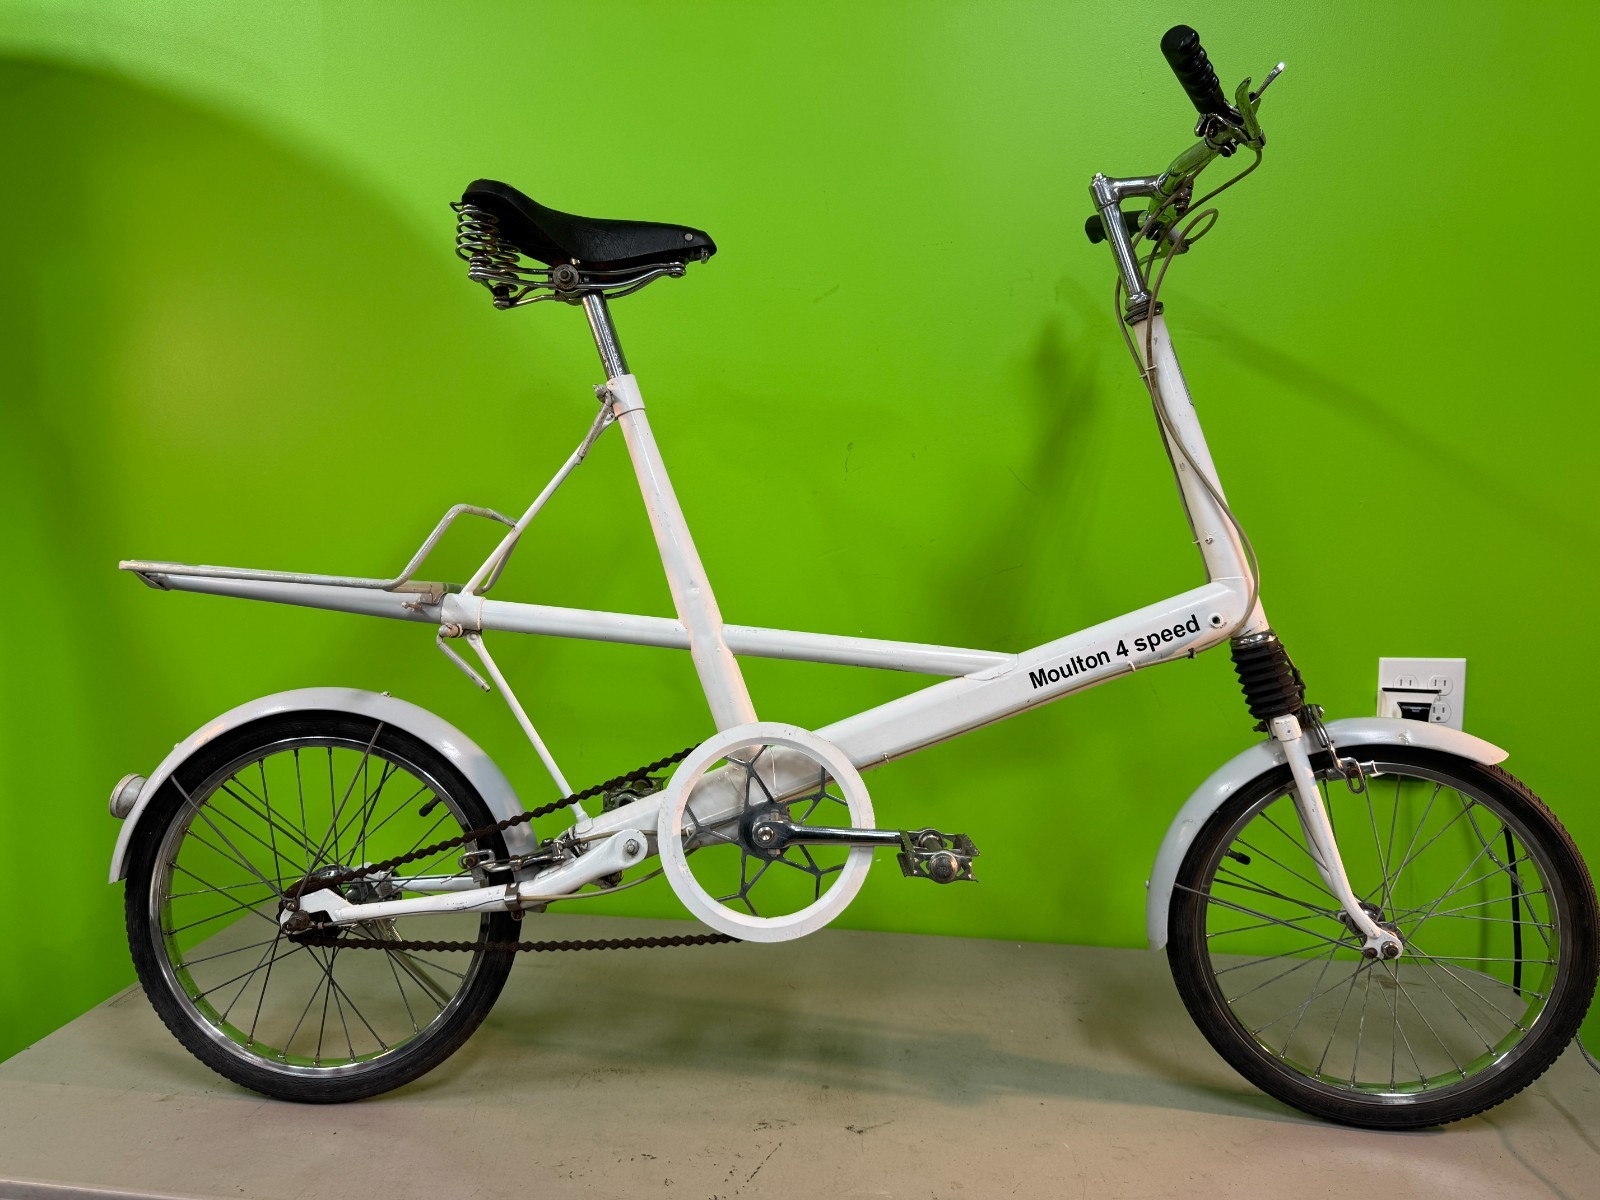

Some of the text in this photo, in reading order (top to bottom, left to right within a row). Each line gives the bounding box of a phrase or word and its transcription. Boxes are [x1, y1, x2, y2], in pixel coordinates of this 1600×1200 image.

[1029, 614, 1201, 689] Moulton 4 speed
